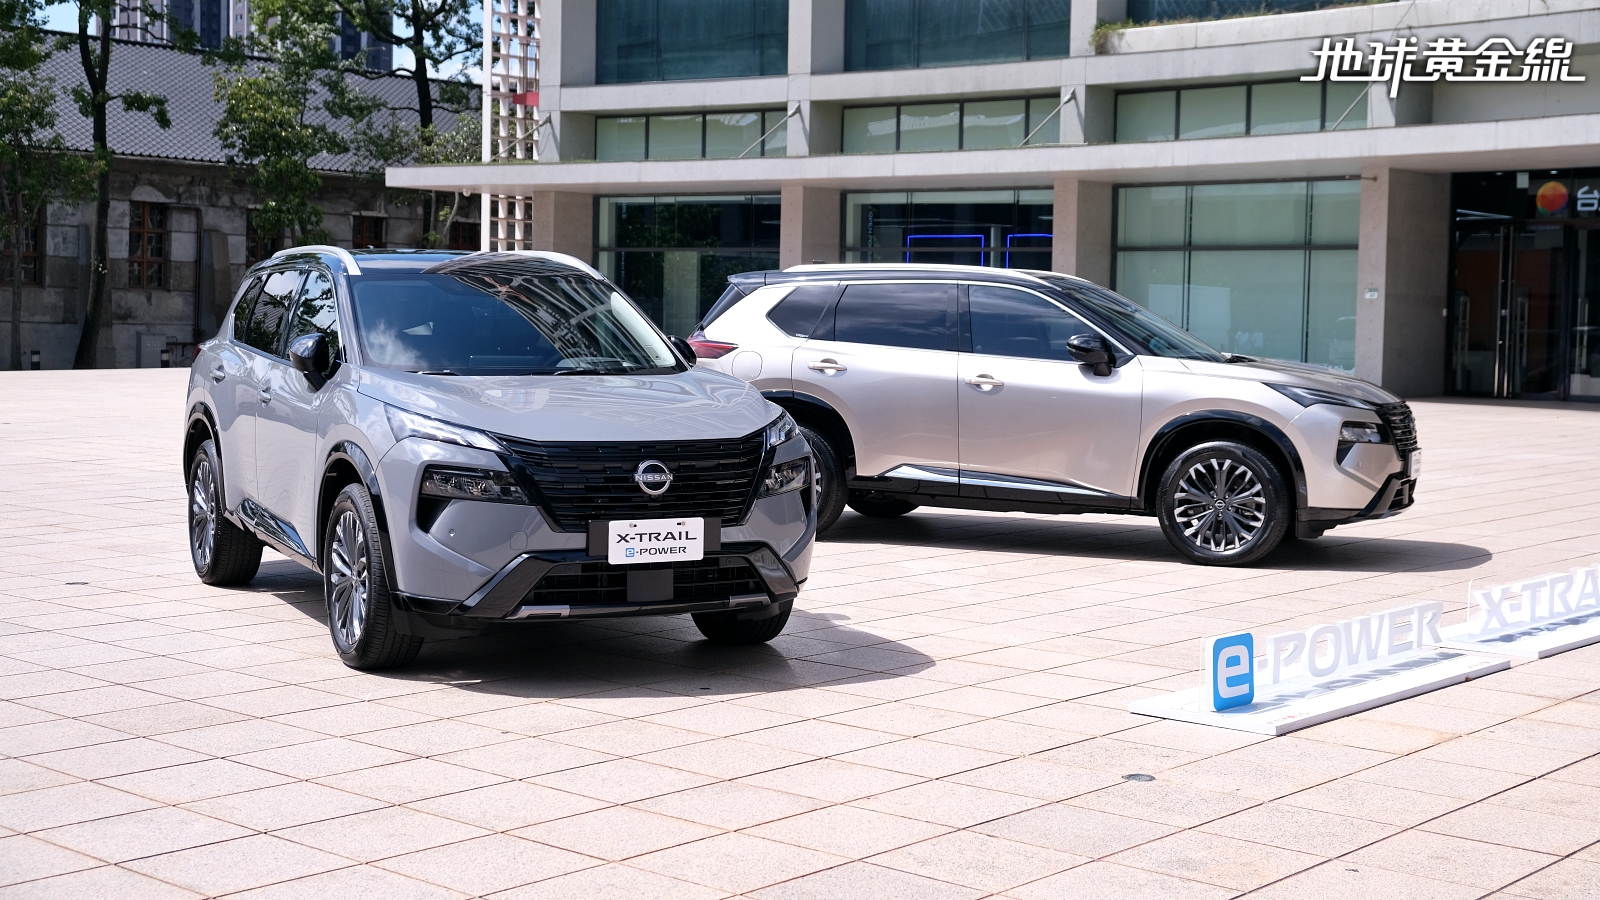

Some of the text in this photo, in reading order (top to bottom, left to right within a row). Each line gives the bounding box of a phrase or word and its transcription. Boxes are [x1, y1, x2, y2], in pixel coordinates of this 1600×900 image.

[1577, 185, 1600, 211] 台
[635, 473, 673, 481] NISSAN
[616, 531, 697, 543] X-TRAIL
[625, 546, 687, 557] e-POWER
[1474, 564, 1600, 635] X-TRA
[1215, 600, 1444, 702] e-POWER
